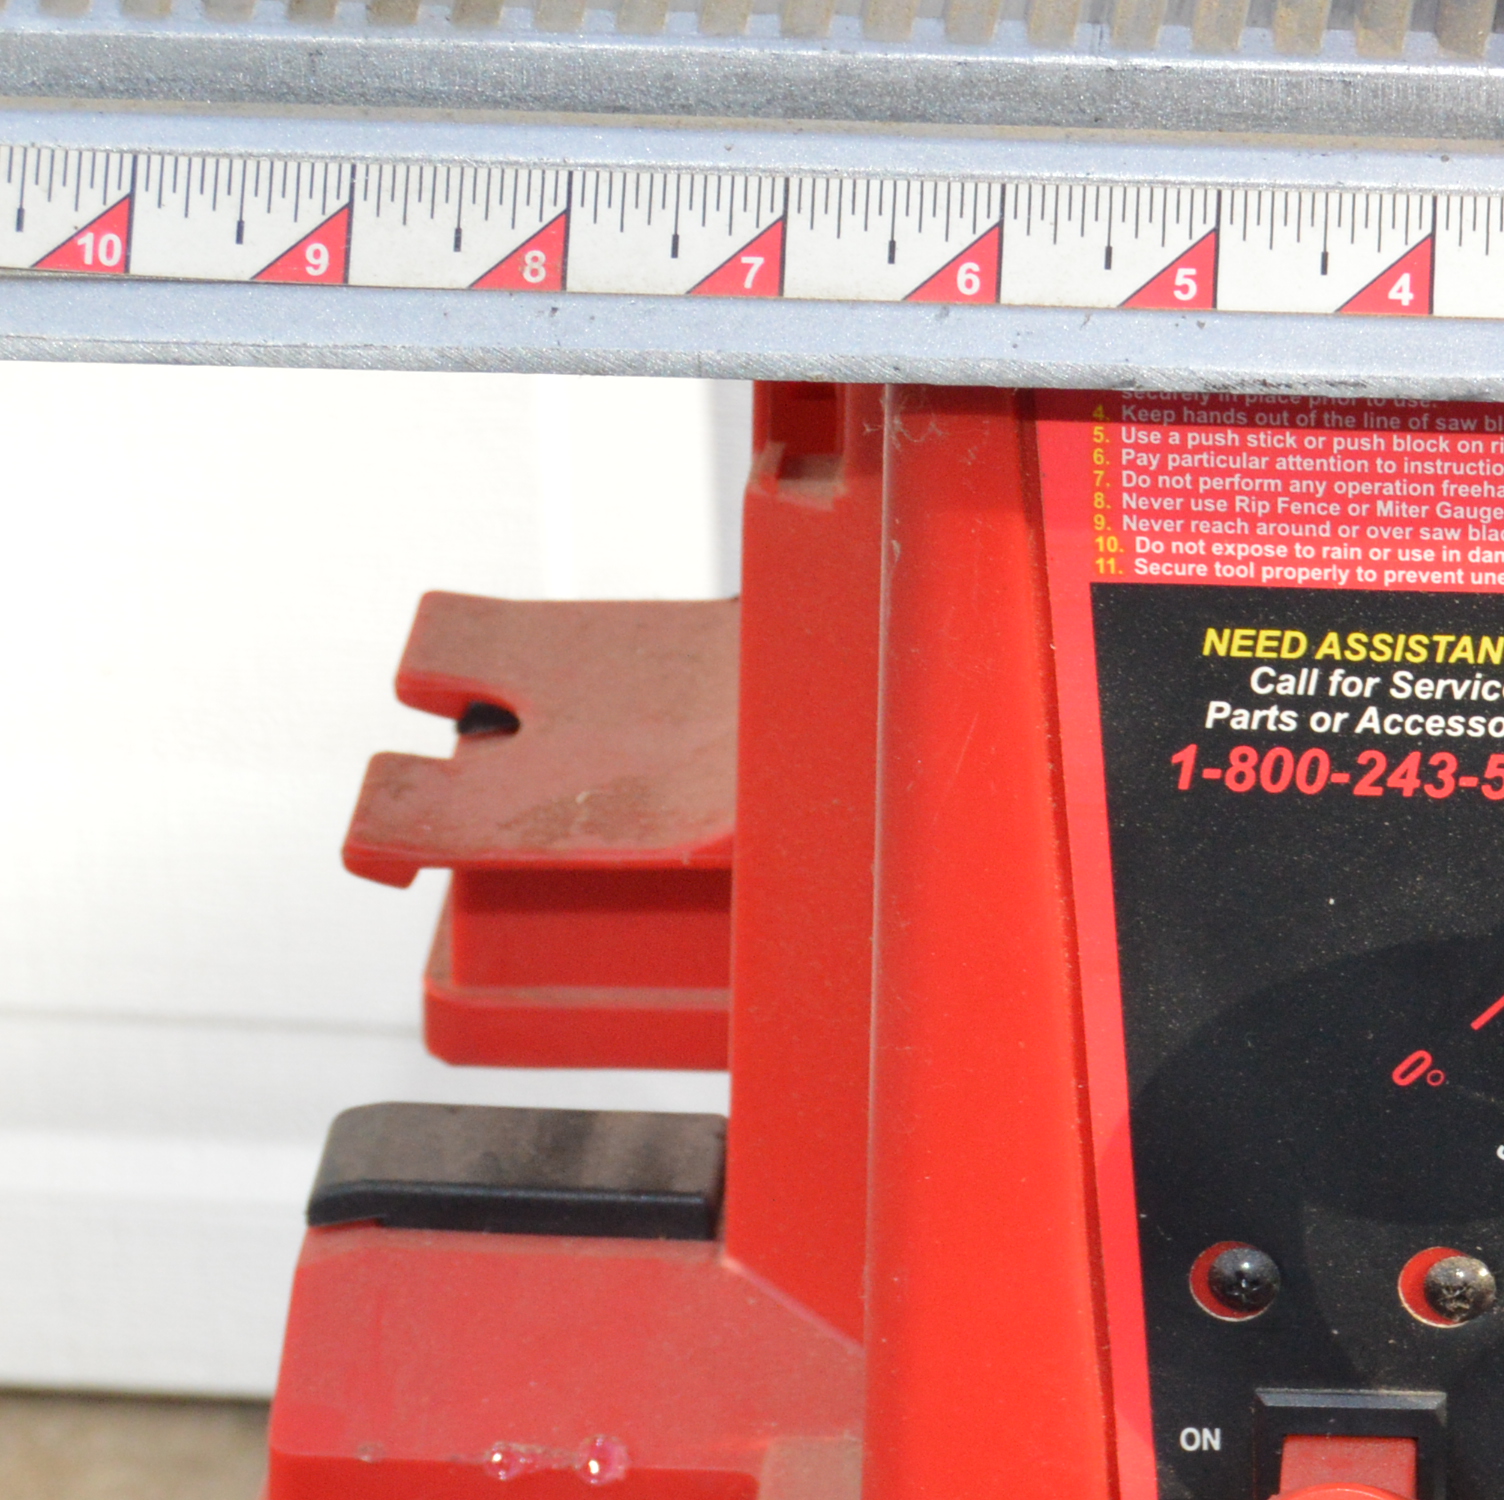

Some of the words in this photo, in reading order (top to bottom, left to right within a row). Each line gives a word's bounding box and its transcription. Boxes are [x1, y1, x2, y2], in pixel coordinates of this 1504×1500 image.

[77, 232, 122, 266] 10
[306, 243, 329, 276] 9
[523, 250, 546, 283] 8
[741, 257, 764, 288] 7
[957, 262, 980, 295] 6
[1174, 268, 1197, 301] 5
[1388, 273, 1414, 306] 4
[1096, 536, 1123, 552] 10.
[1136, 536, 1164, 553] Do
[1172, 539, 1205, 555] not
[1212, 542, 1288, 561] expose
[1294, 542, 1315, 559] to
[1322, 542, 1362, 560] rain
[1369, 547, 1391, 561] or
[1398, 548, 1435, 562] use
[1442, 545, 1461, 563] in
[1096, 557, 1122, 574] 11.
[1135, 557, 1207, 577] Secure
[1214, 561, 1254, 578] tool
[1262, 564, 1349, 586] properly
[1356, 566, 1377, 582] to
[1384, 569, 1464, 586] prevent
[1203, 628, 1307, 659] NEED
[1251, 666, 1319, 696] Call
[1329, 668, 1380, 697] for
[1205, 701, 1298, 732] Parts
[1310, 711, 1349, 733] or
[1180, 1427, 1220, 1451] ON
